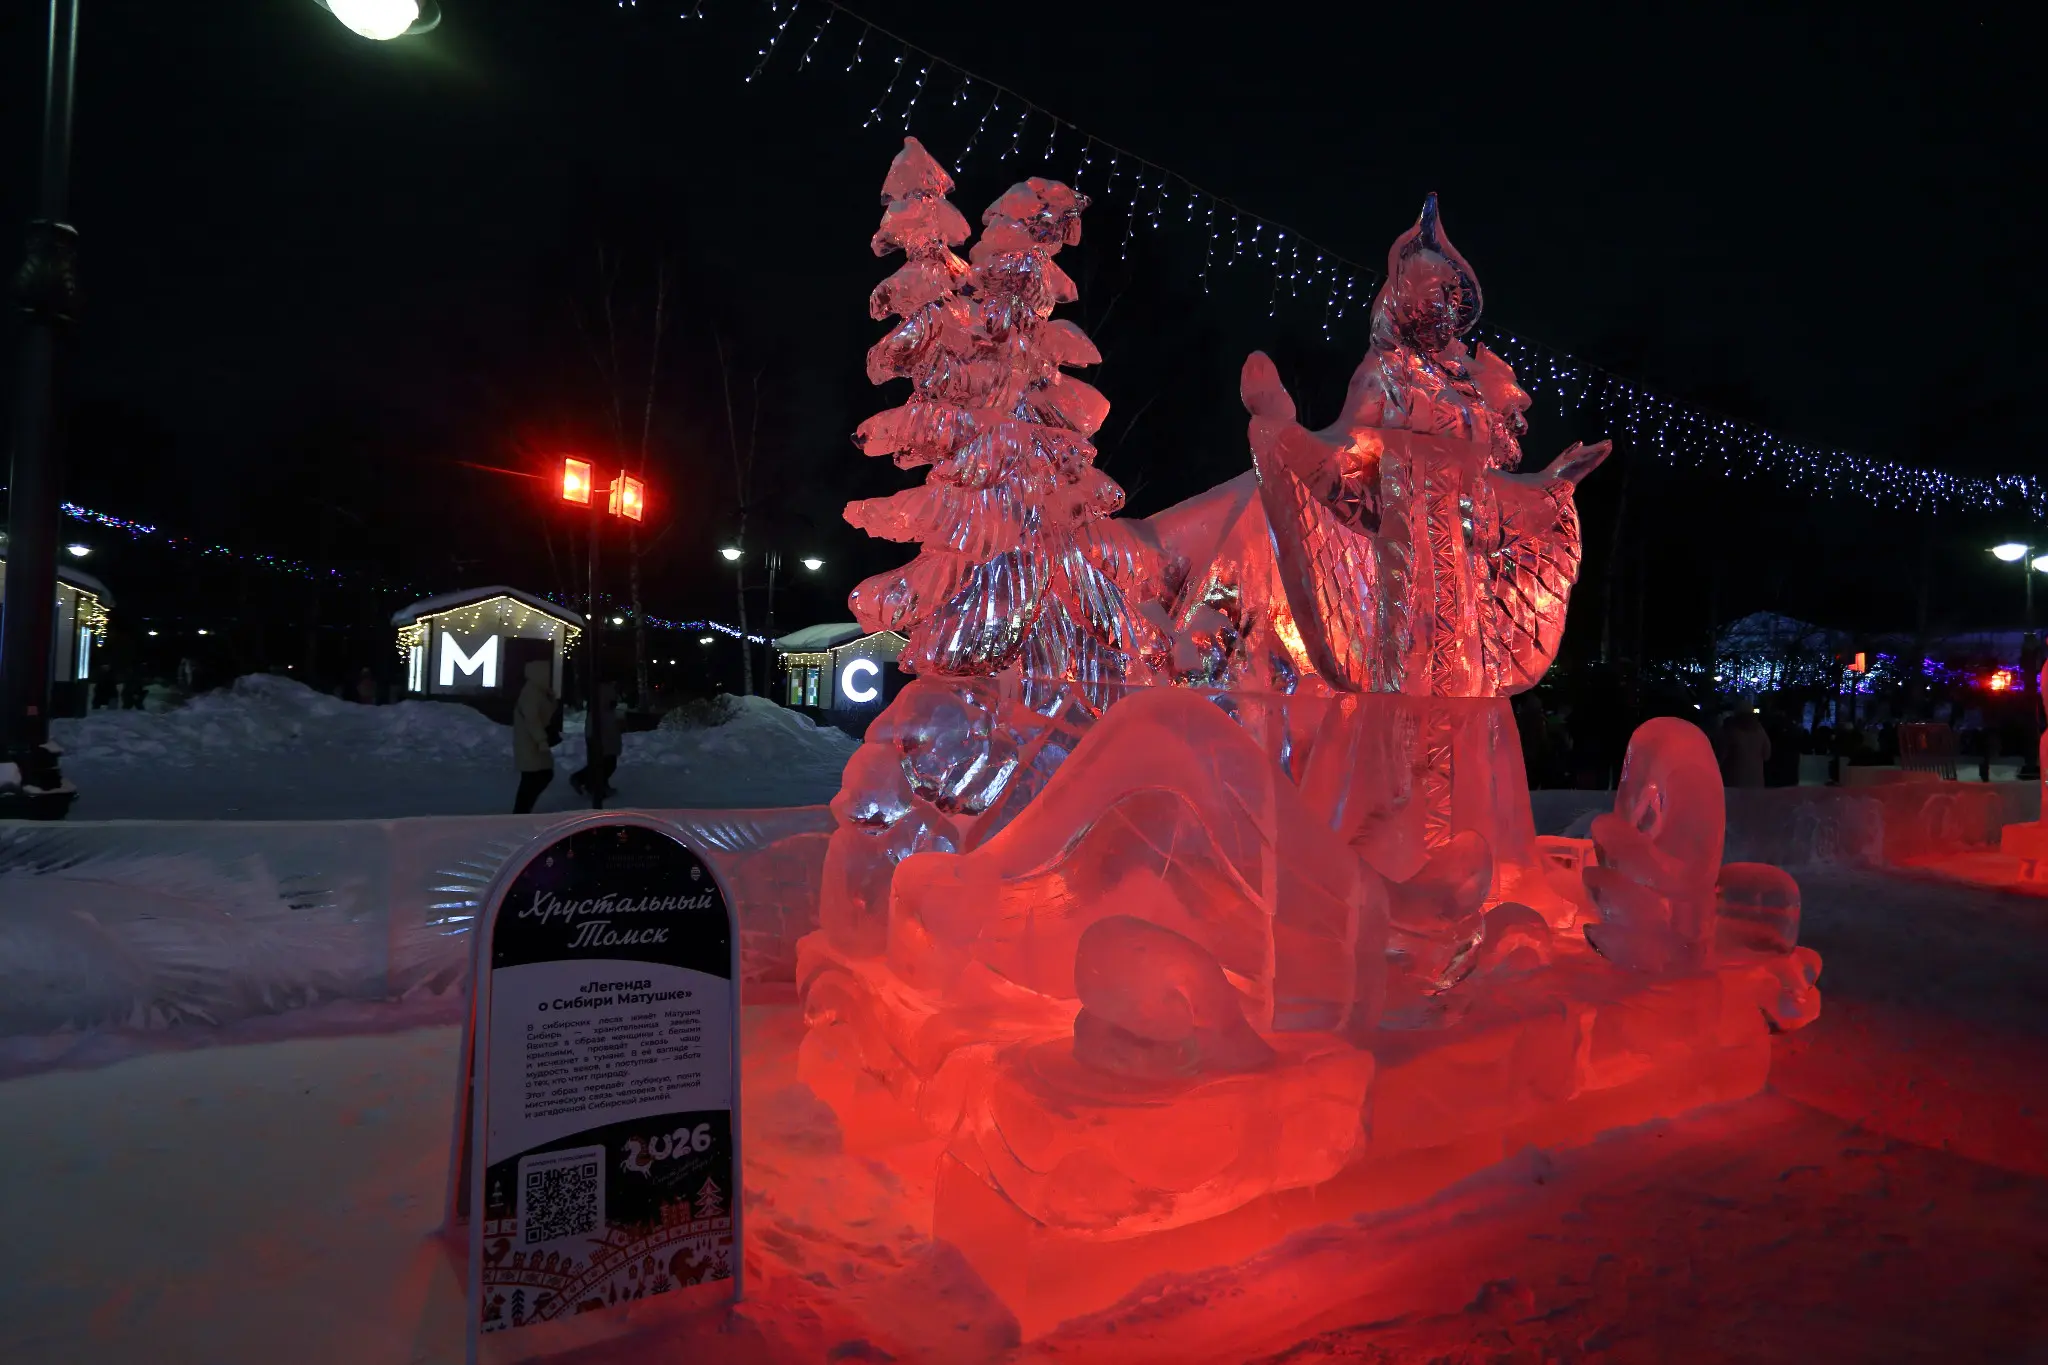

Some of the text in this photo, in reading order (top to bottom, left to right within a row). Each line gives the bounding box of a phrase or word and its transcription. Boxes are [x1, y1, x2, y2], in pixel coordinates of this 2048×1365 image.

[518, 887, 716, 925] Хрустальный
[567, 920, 670, 948] Томск
[580, 979, 652, 993] «Легенда
[538, 989, 692, 1011] о Сибири Матушке»
